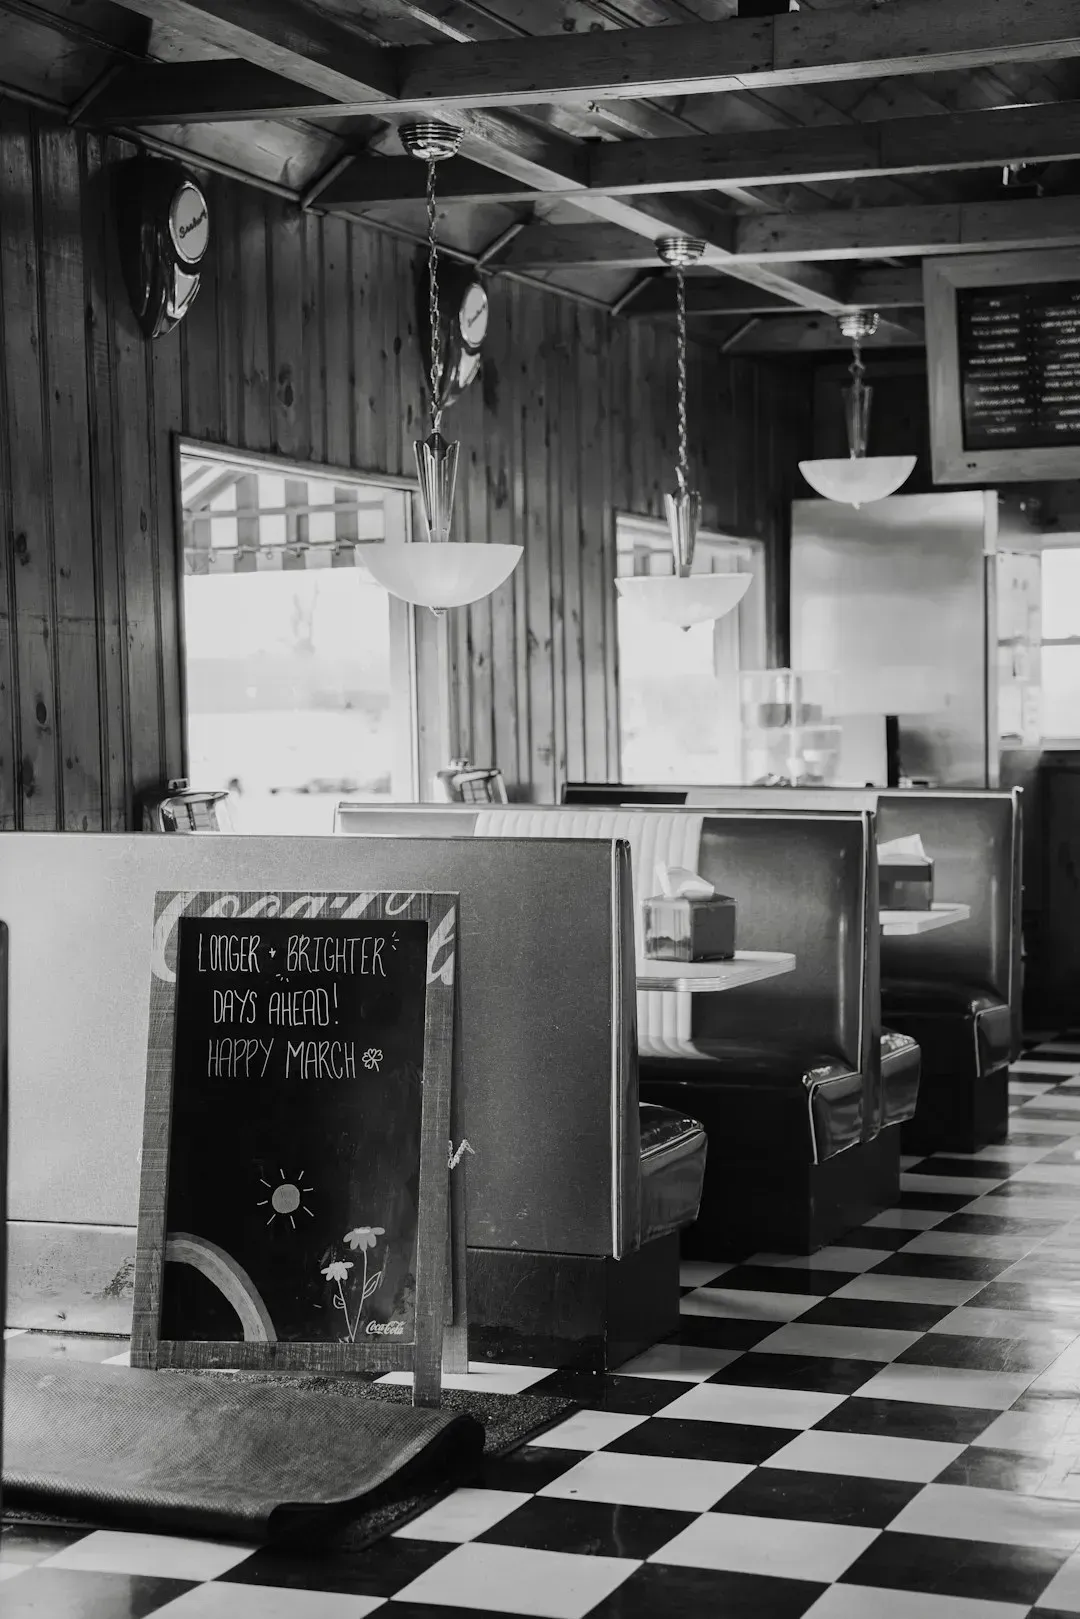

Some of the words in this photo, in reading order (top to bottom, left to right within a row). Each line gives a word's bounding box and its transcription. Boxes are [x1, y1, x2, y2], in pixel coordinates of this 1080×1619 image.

[198, 933, 261, 973] LONGER
[286, 934, 387, 977] BRIGHTER
[213, 989, 258, 1024] DAYS
[268, 982, 339, 1026] AHEAD!
[207, 1037, 275, 1078] HAPPY
[285, 1040, 356, 1080] MARCH
